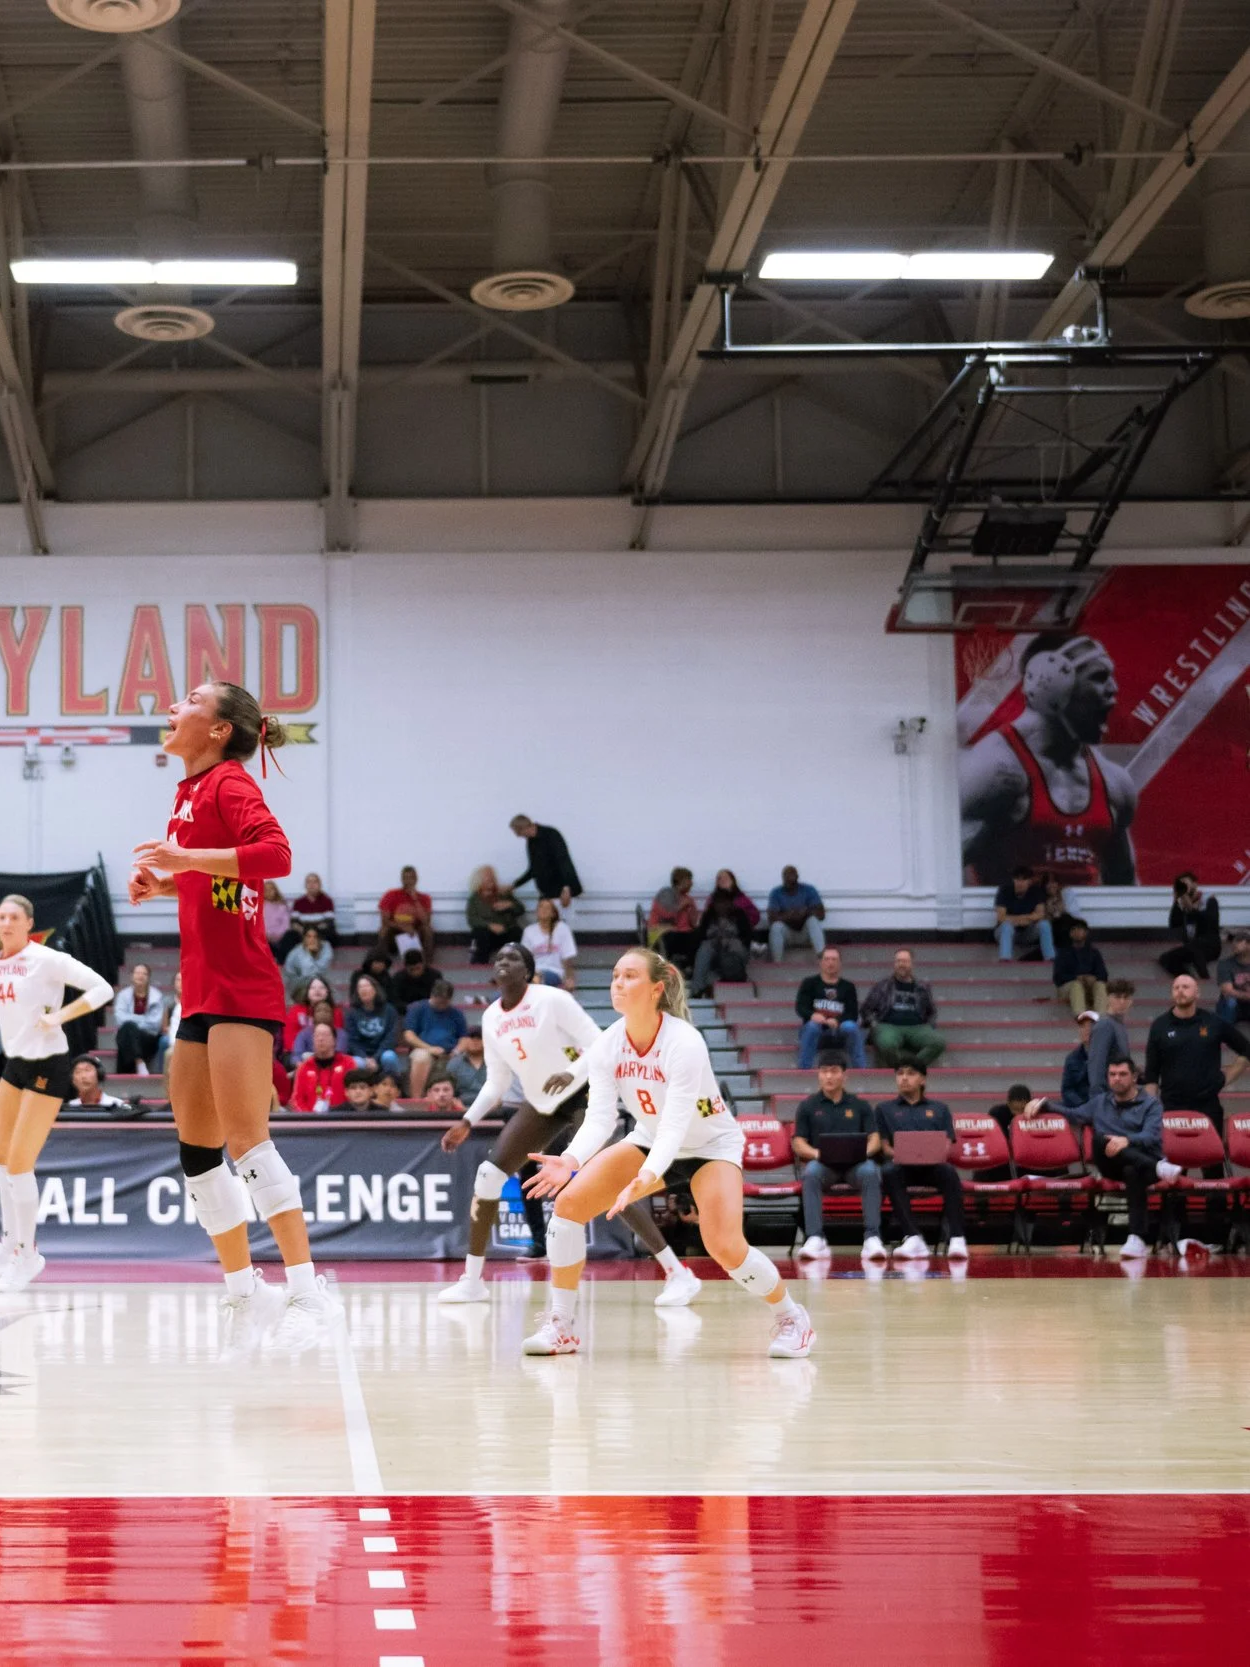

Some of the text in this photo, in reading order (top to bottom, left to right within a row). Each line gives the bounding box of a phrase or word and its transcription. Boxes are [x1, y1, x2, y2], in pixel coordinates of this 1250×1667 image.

[511, 1037, 527, 1061] 3
[614, 1061, 666, 1083] MARYLAN
[636, 1088, 657, 1116] 8
[955, 1118, 995, 1131] ARYLAND
[147, 1173, 454, 1226] CENGE
